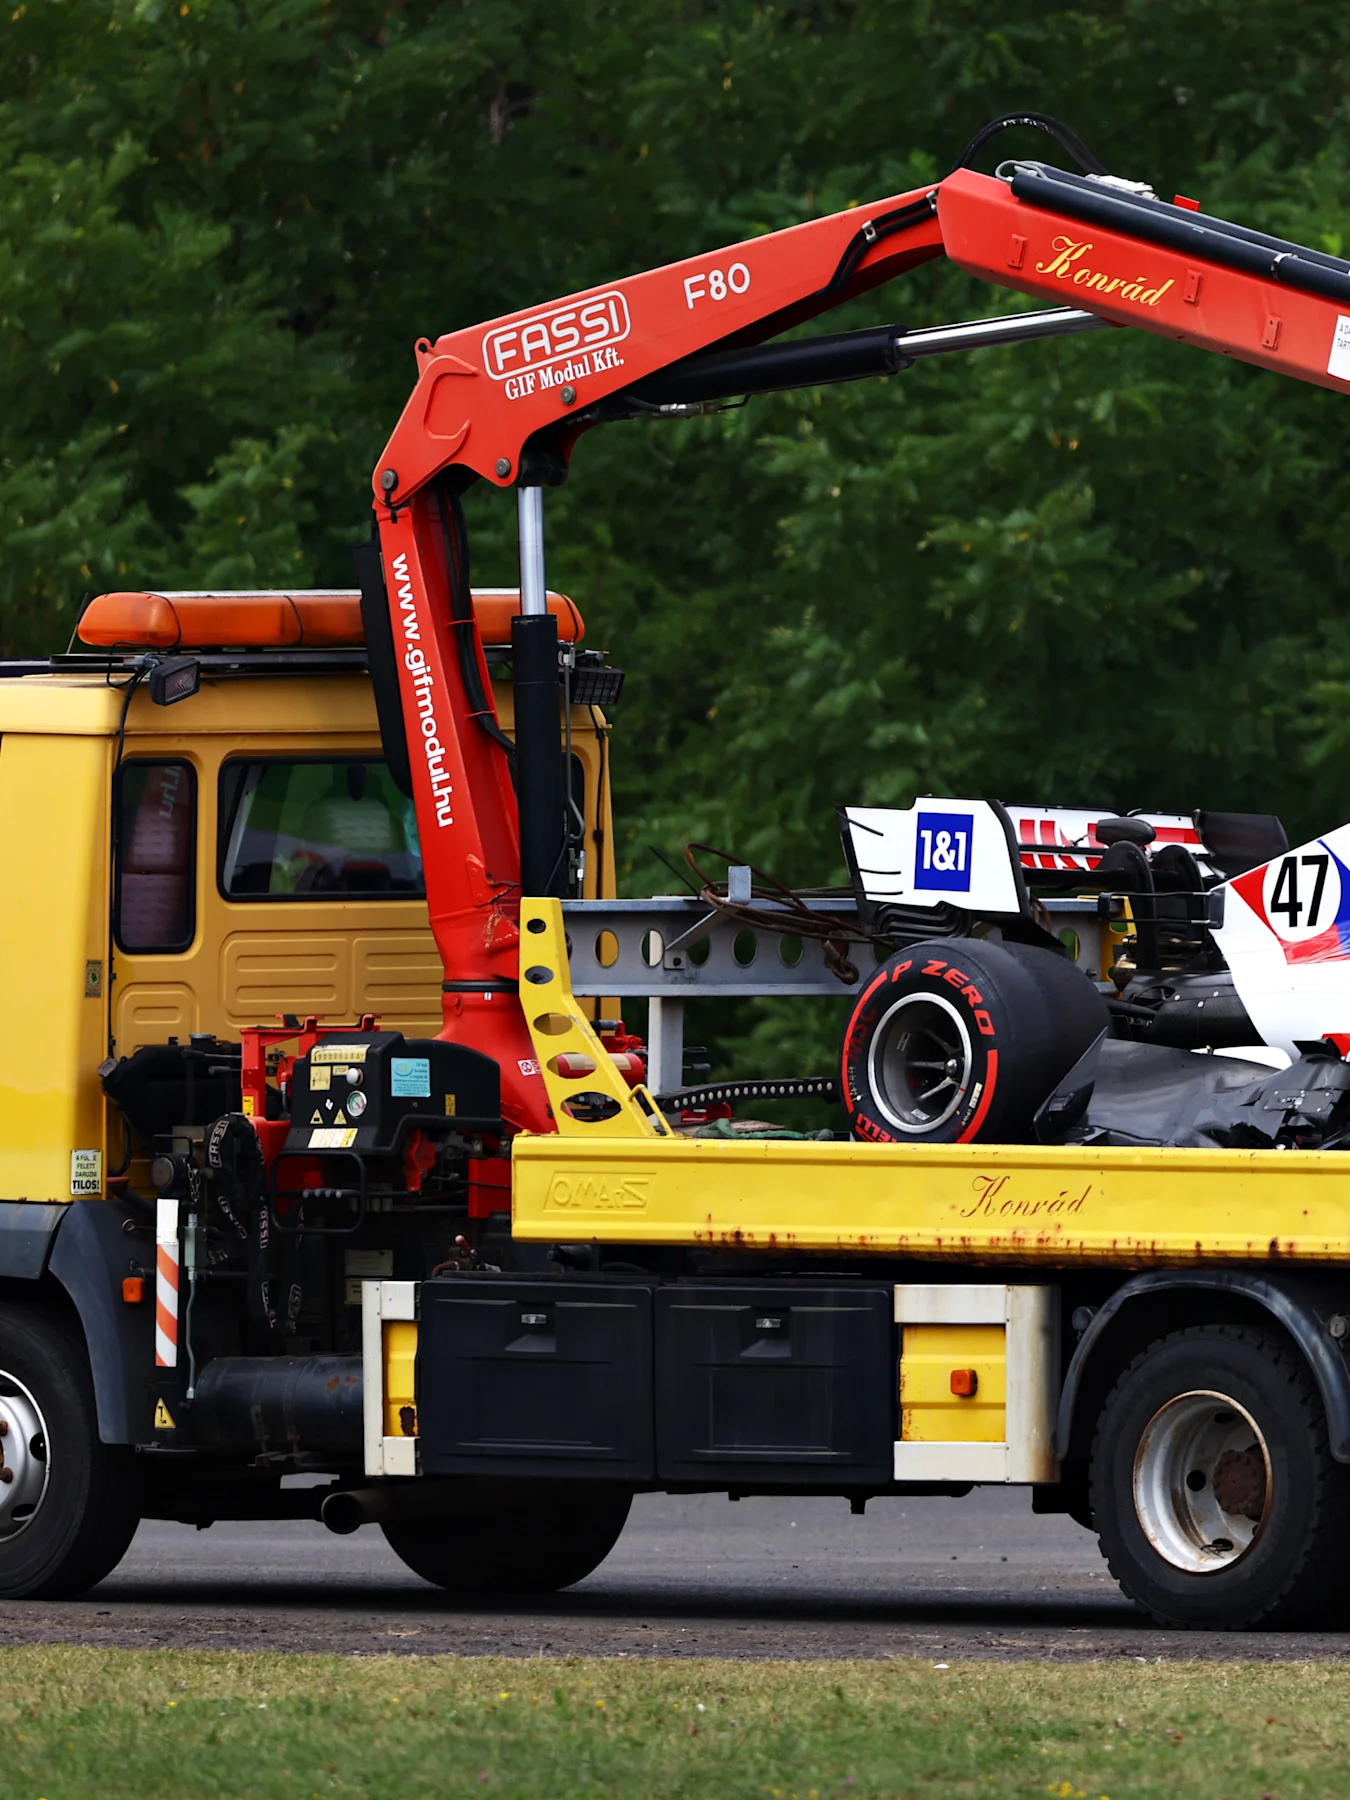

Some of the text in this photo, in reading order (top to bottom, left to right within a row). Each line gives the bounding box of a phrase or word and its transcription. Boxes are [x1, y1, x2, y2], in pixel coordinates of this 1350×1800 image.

[683, 262, 751, 309] F80
[1035, 235, 1175, 306] Konrád
[492, 299, 620, 371] FASSI
[1339, 324, 1344, 333] A
[505, 347, 625, 400] GIF Modul Kft.
[392, 553, 454, 828] www.gifmodul.hu
[920, 829, 967, 872] 1&1
[1270, 854, 1329, 928] 47
[921, 960, 995, 1036] ZERO
[72, 1179, 100, 1190] TILOS!
[960, 1175, 1093, 1218] Konrád
